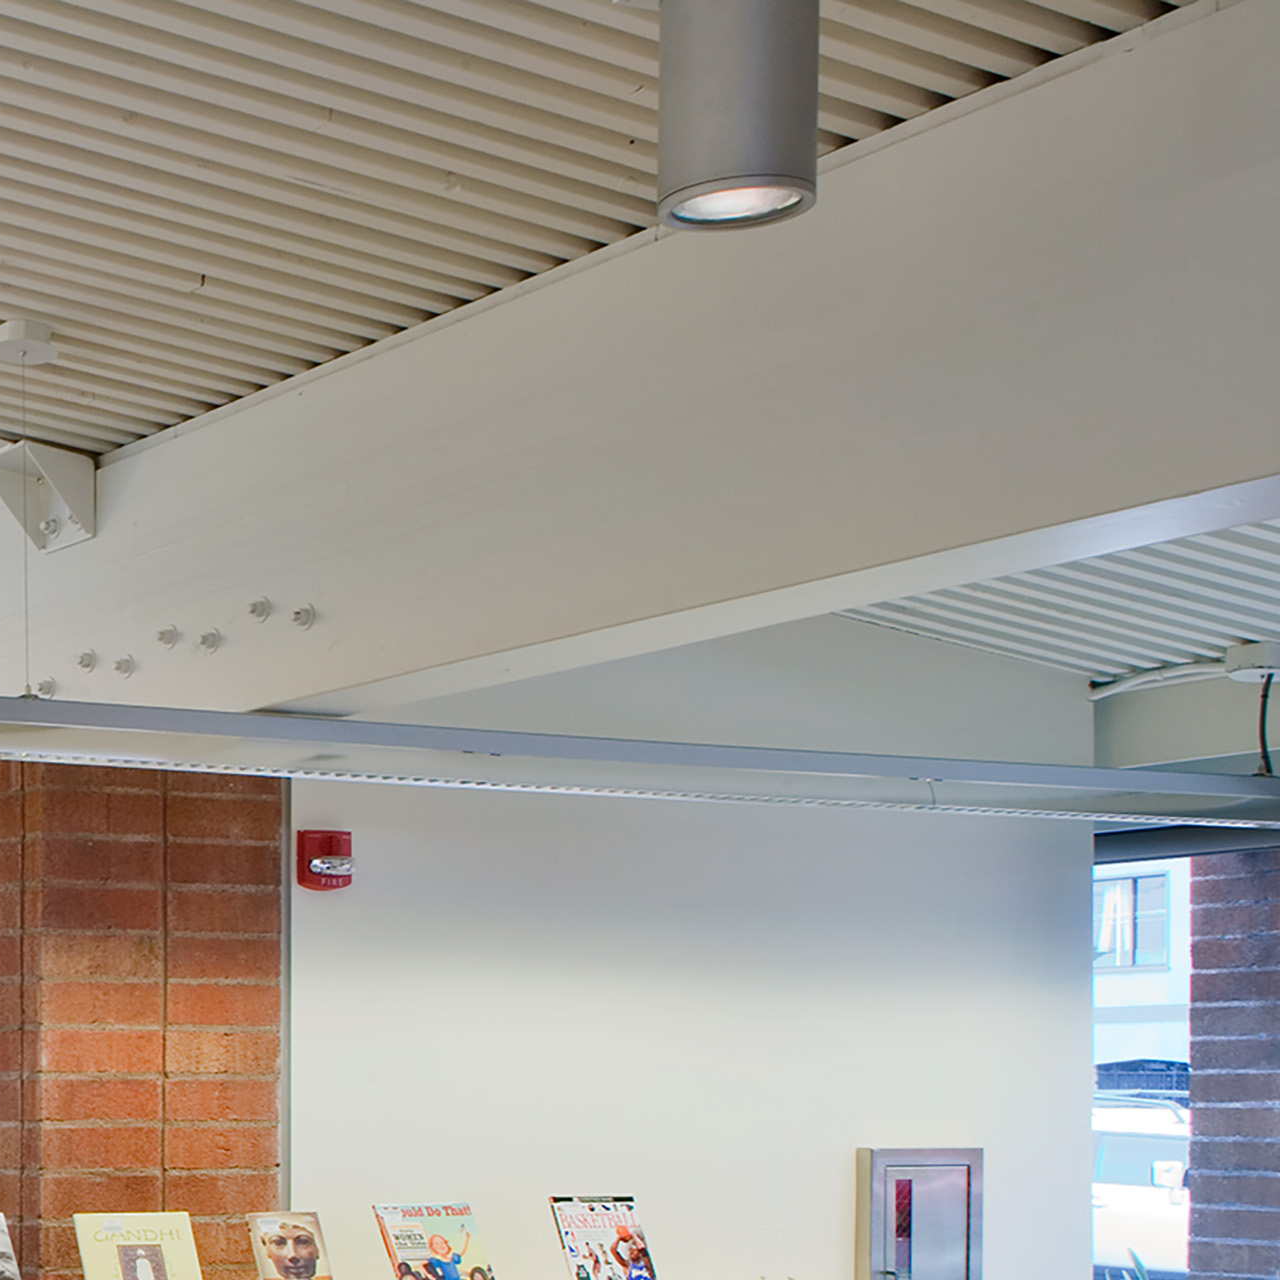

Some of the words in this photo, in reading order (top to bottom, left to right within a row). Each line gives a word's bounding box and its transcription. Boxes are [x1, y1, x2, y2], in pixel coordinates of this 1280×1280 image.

[320, 878, 343, 887] FIRE
[425, 1206, 442, 1217] Do
[442, 1205, 472, 1217] That!
[558, 1212, 641, 1229] BASKETBALL
[93, 1228, 181, 1243] GANDHI
